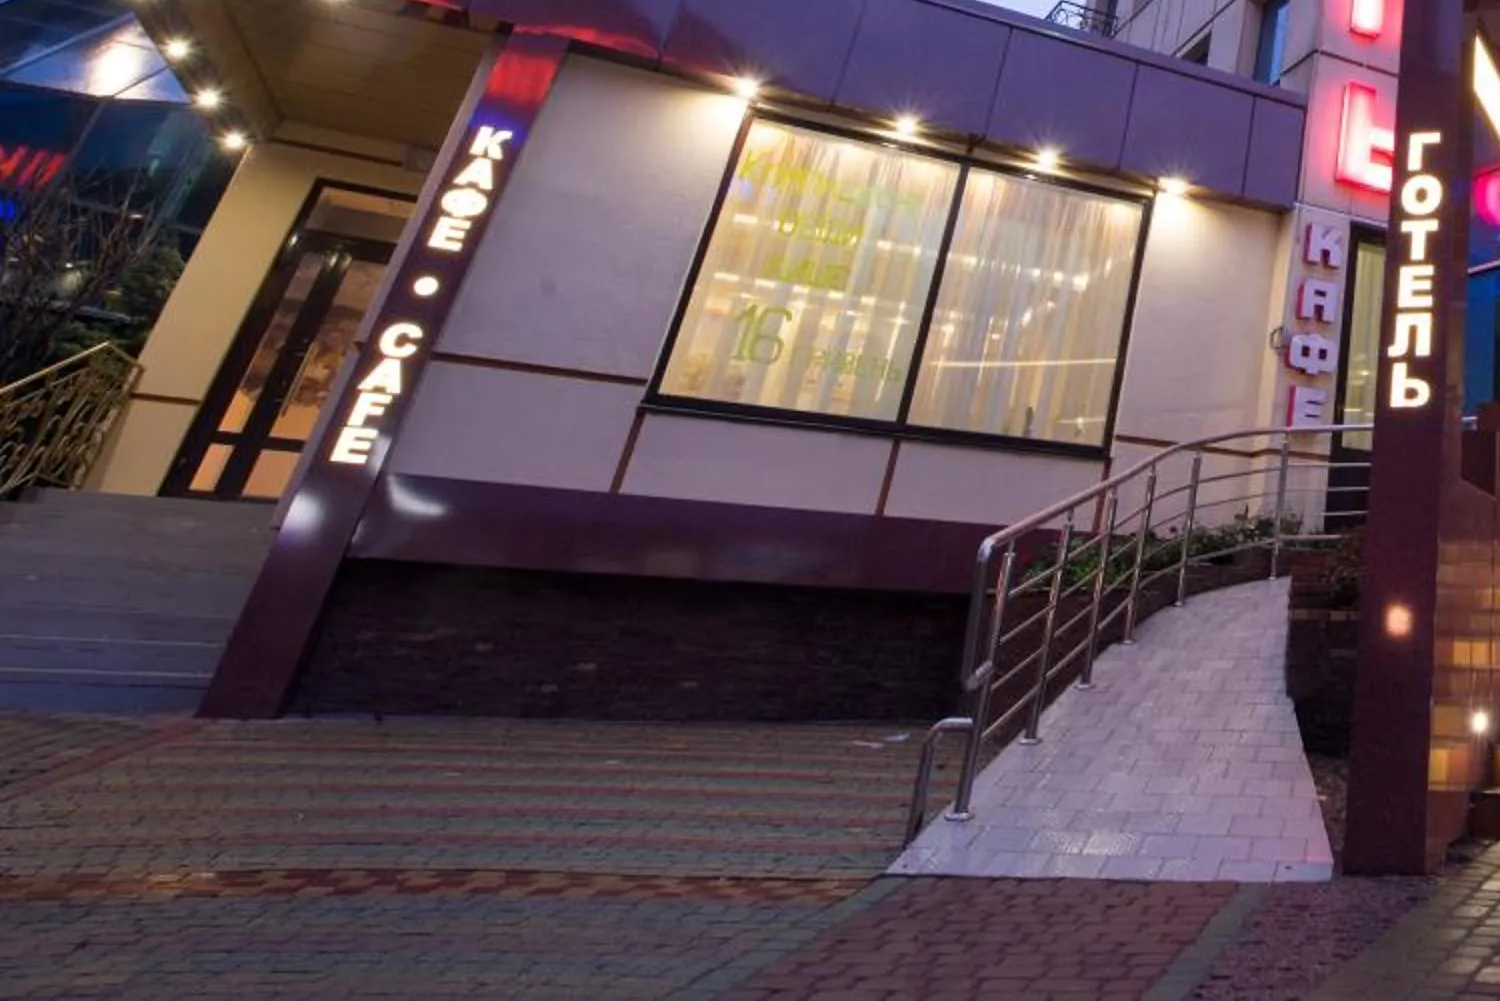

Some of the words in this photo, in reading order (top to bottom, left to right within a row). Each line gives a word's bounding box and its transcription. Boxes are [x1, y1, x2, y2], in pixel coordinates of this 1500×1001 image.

[427, 125, 514, 253] КАФЕ
[1387, 131, 1444, 409] ГОТЕЛЬ
[329, 322, 424, 465] CAFE
[1285, 222, 1343, 430] КАФЕ
